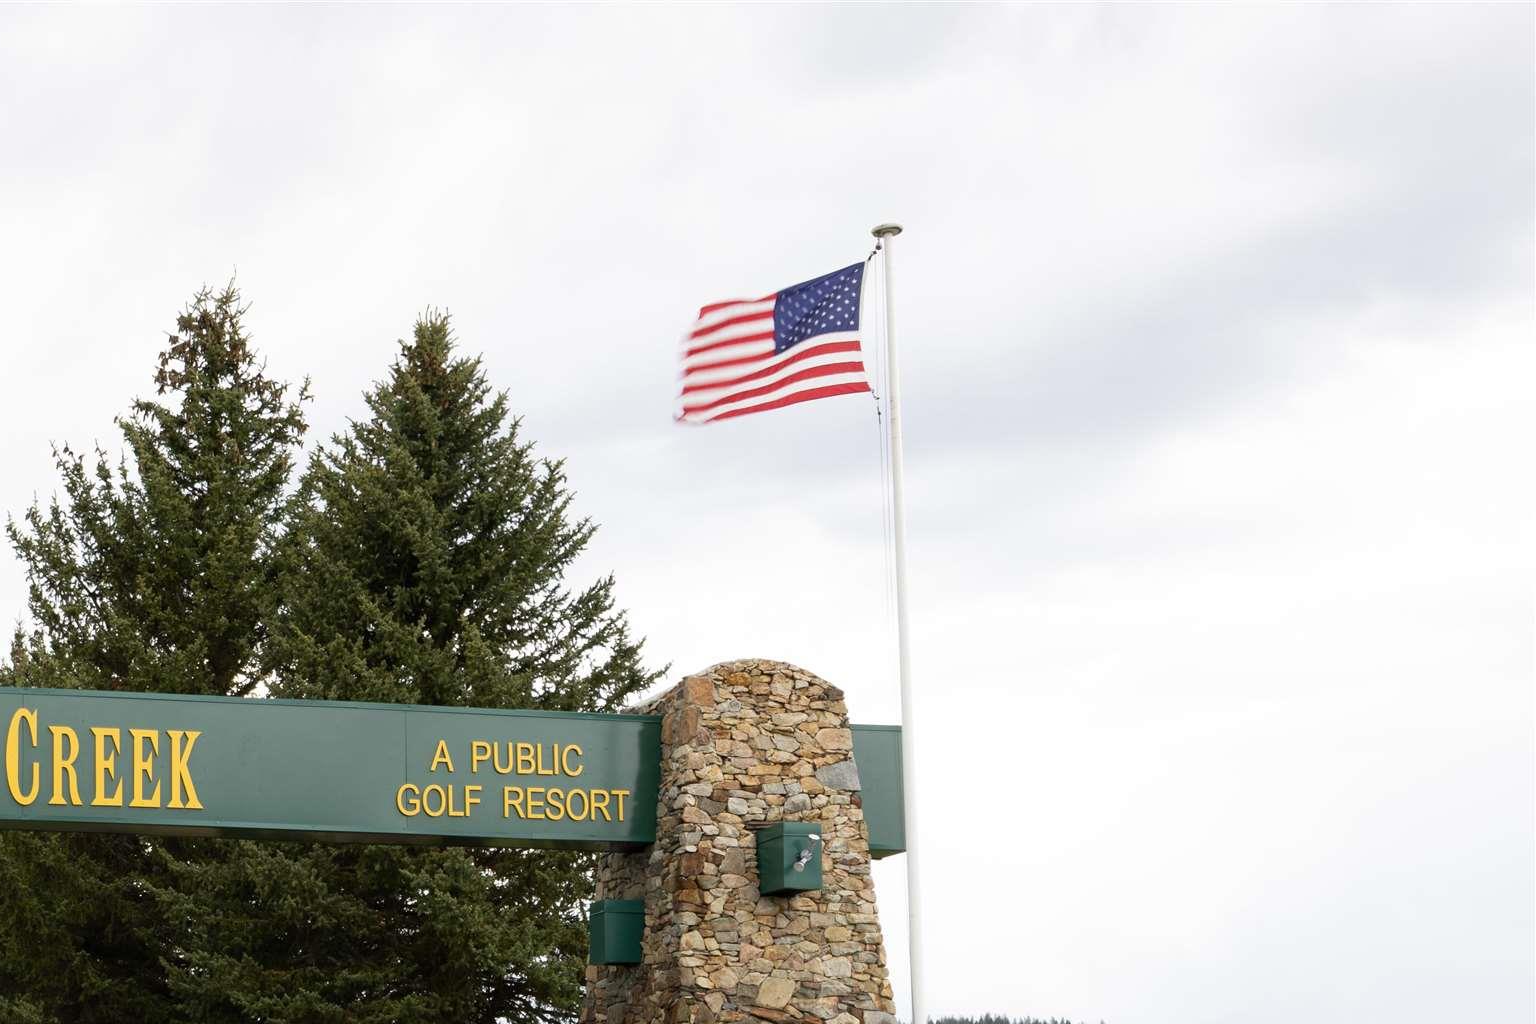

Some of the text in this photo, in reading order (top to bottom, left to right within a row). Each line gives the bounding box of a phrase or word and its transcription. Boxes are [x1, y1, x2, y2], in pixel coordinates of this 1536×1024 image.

[431, 739, 585, 777] A PUBLIC
[396, 783, 630, 821] GOLF RESORT
